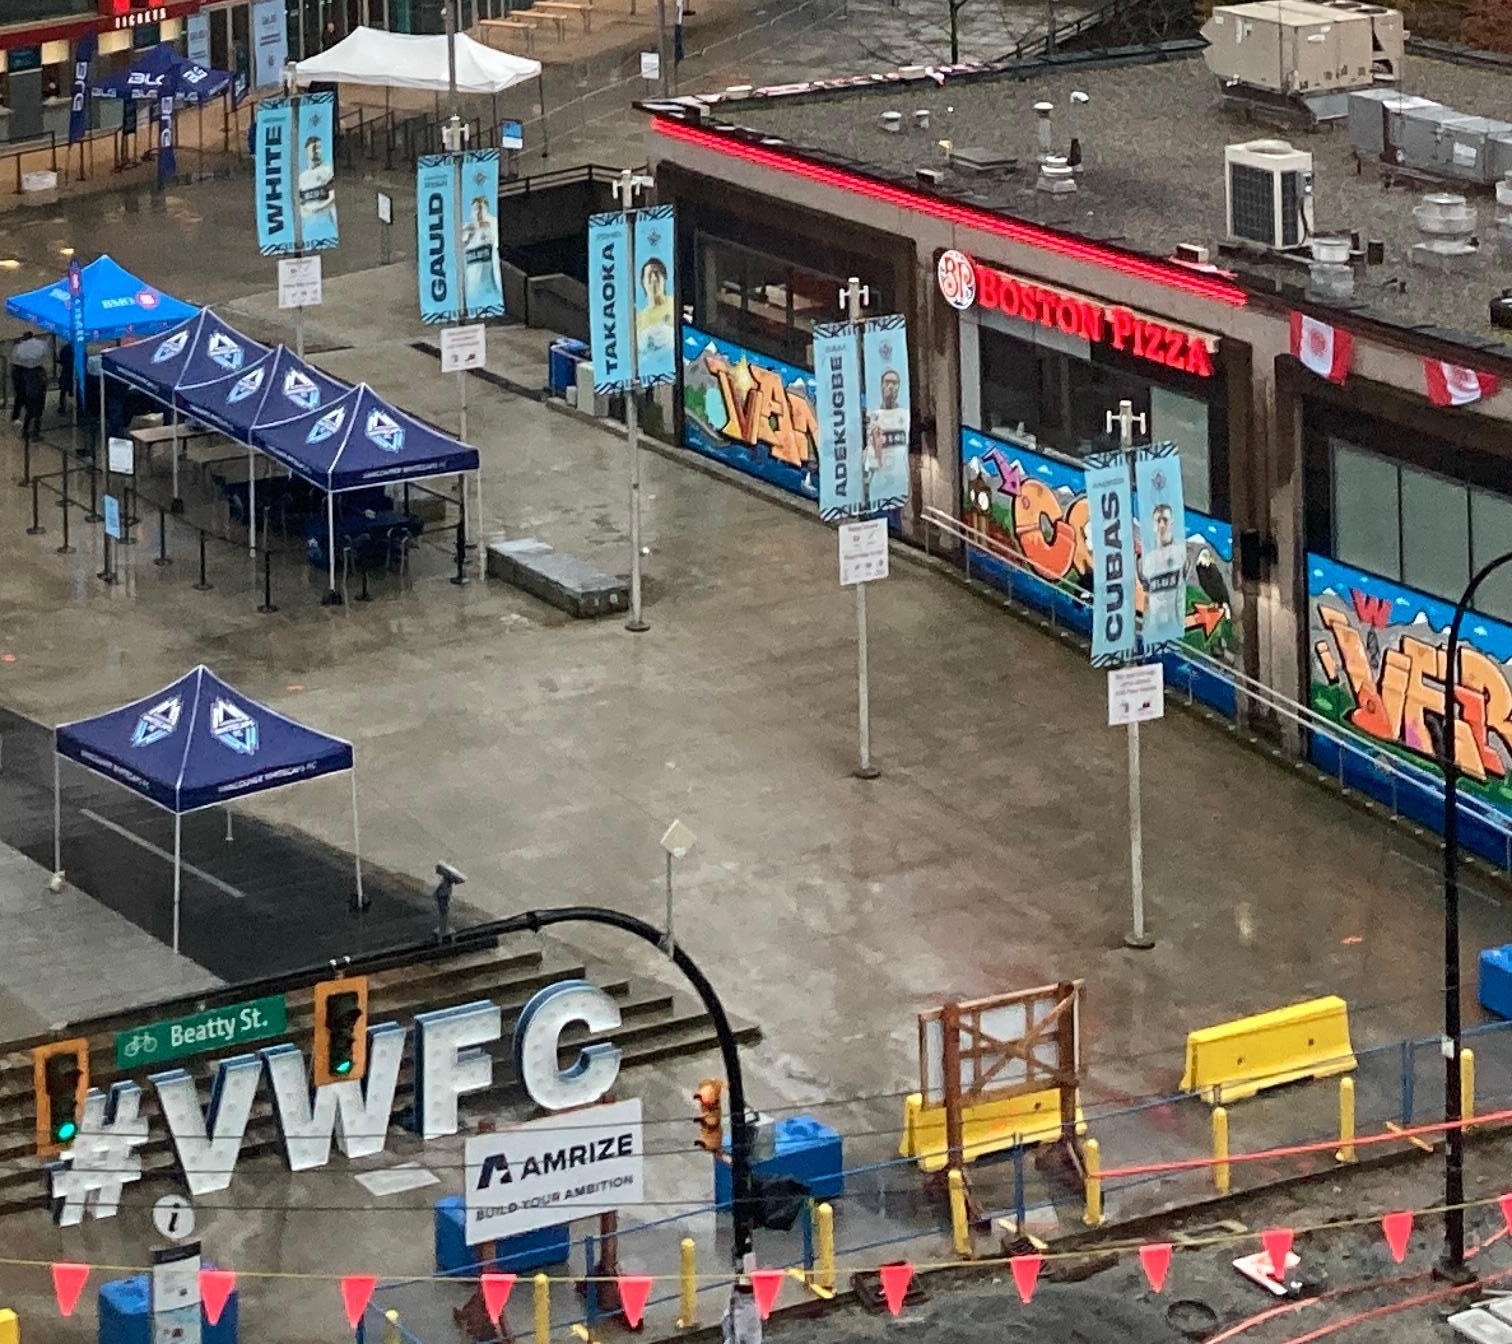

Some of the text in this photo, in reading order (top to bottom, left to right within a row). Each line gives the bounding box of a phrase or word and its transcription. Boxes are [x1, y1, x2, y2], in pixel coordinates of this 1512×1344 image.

[265, 124, 285, 236] WHITE
[428, 192, 448, 303] GAULD
[602, 241, 618, 376] TAKAOKA
[975, 263, 1215, 378] BOSTON PIZZA
[830, 355, 848, 497] ADEKUGBE
[1102, 491, 1124, 643] CUBAS
[171, 1008, 268, 1047] Beatty St.
[51, 980, 622, 1227] #VWFC
[521, 1133, 633, 1180] AMRIZE
[476, 1174, 634, 1221] BUILD YOUR AMBITION
